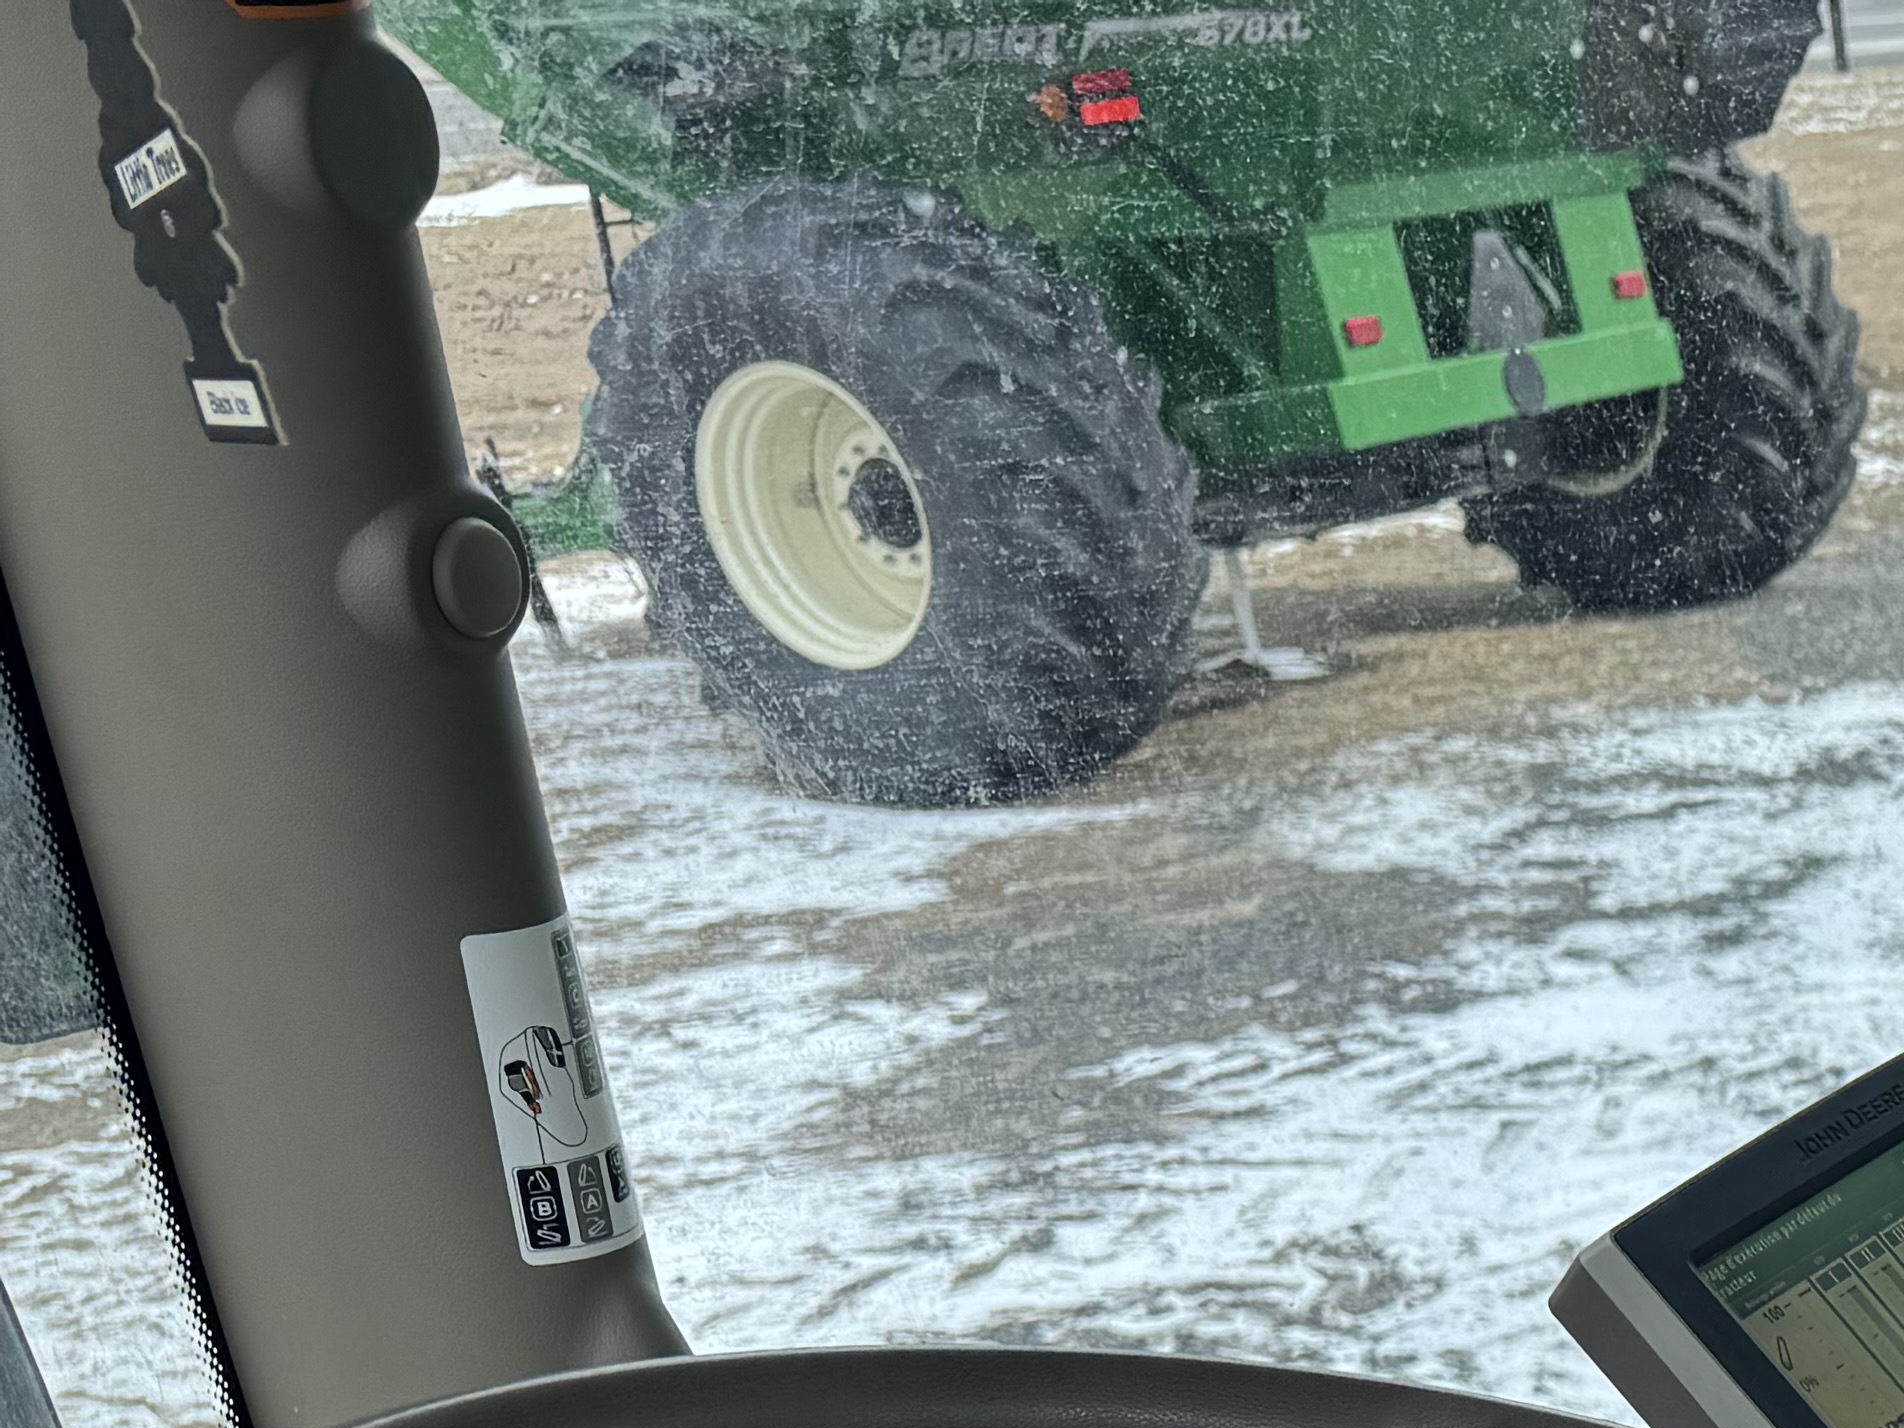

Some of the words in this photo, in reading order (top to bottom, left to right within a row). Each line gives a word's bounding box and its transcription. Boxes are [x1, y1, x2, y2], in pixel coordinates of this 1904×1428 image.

[1795, 1123, 1845, 1165] JOHN
[1859, 1246, 1875, 1262] II
[1761, 1303, 1786, 1325] 100
